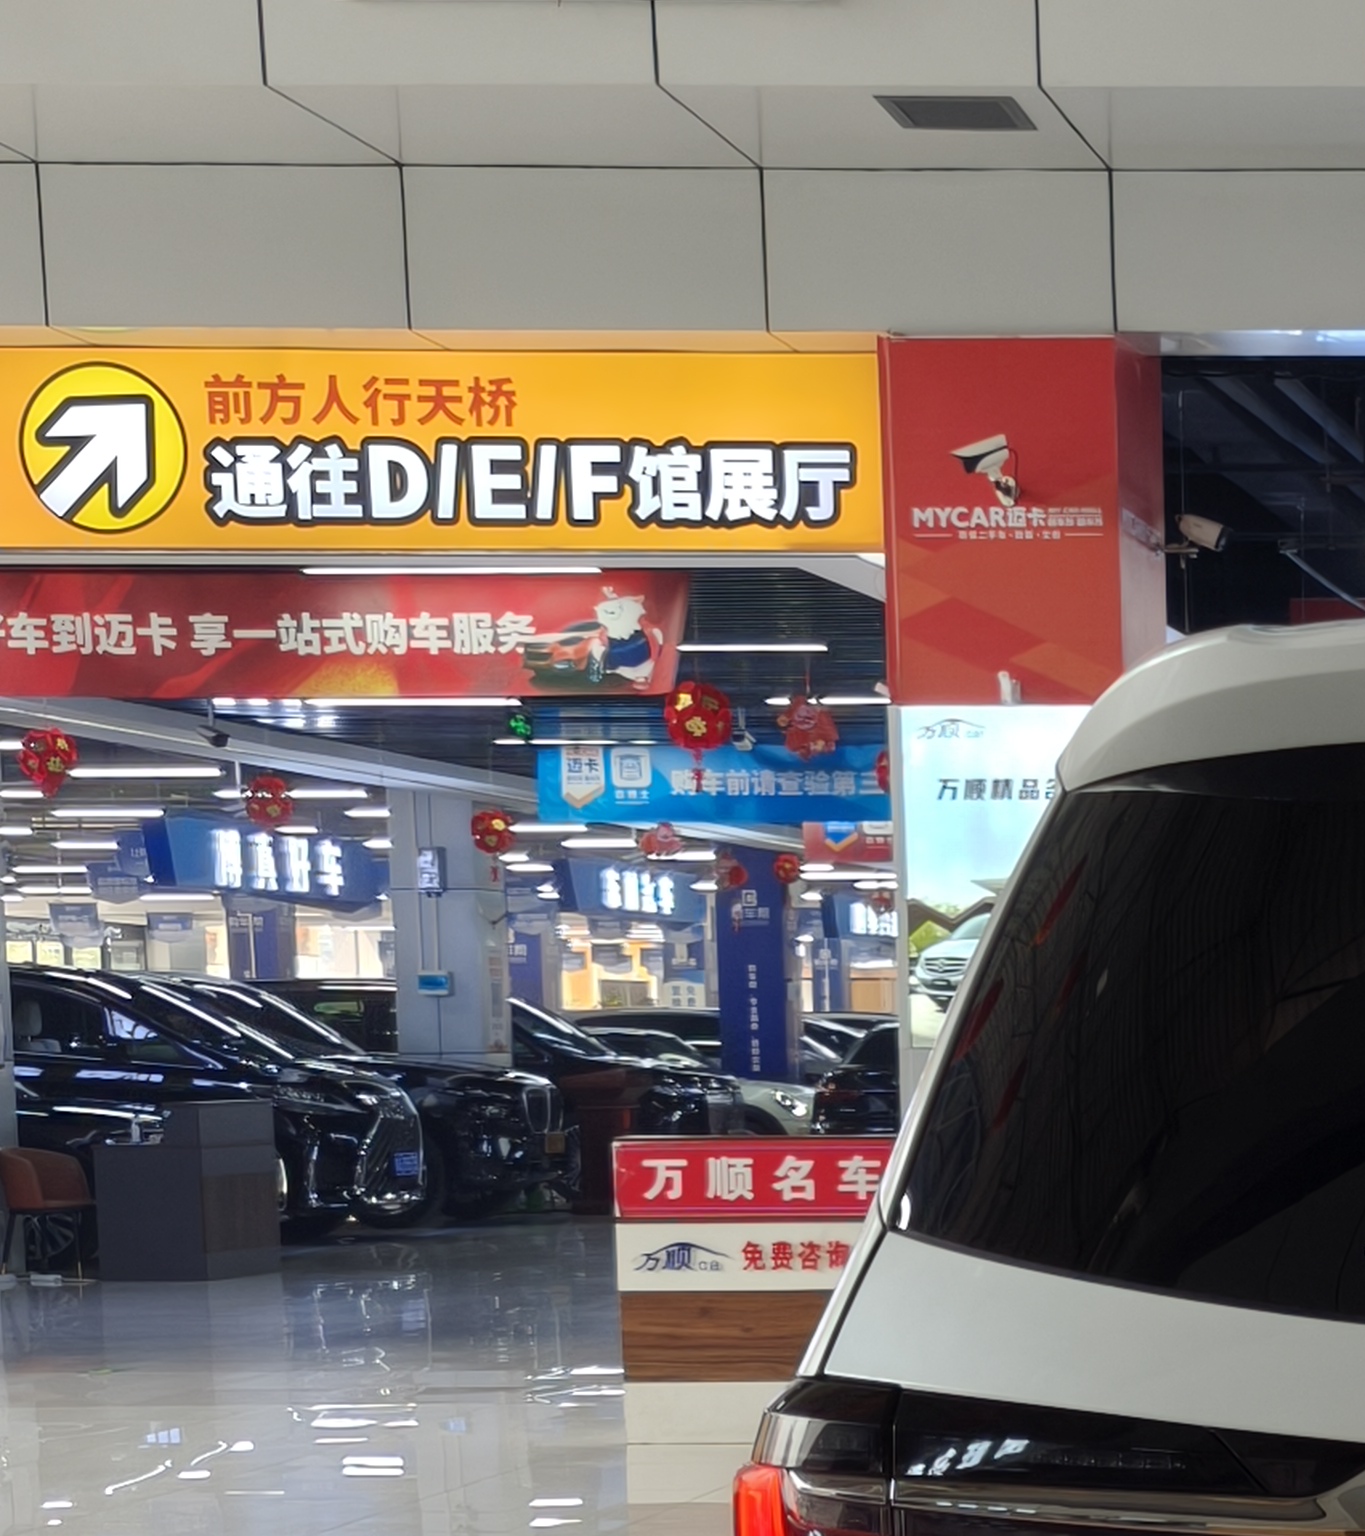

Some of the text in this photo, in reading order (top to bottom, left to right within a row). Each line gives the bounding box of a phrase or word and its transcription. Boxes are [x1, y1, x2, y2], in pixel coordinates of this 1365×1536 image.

[204, 374, 518, 428] 前方人行天桥
[208, 441, 855, 524] 通往D/E/F馆展厅
[0, 612, 537, 656] 车到迈卡 享一站式购车服务
[642, 1155, 881, 1201] 万顺名车
